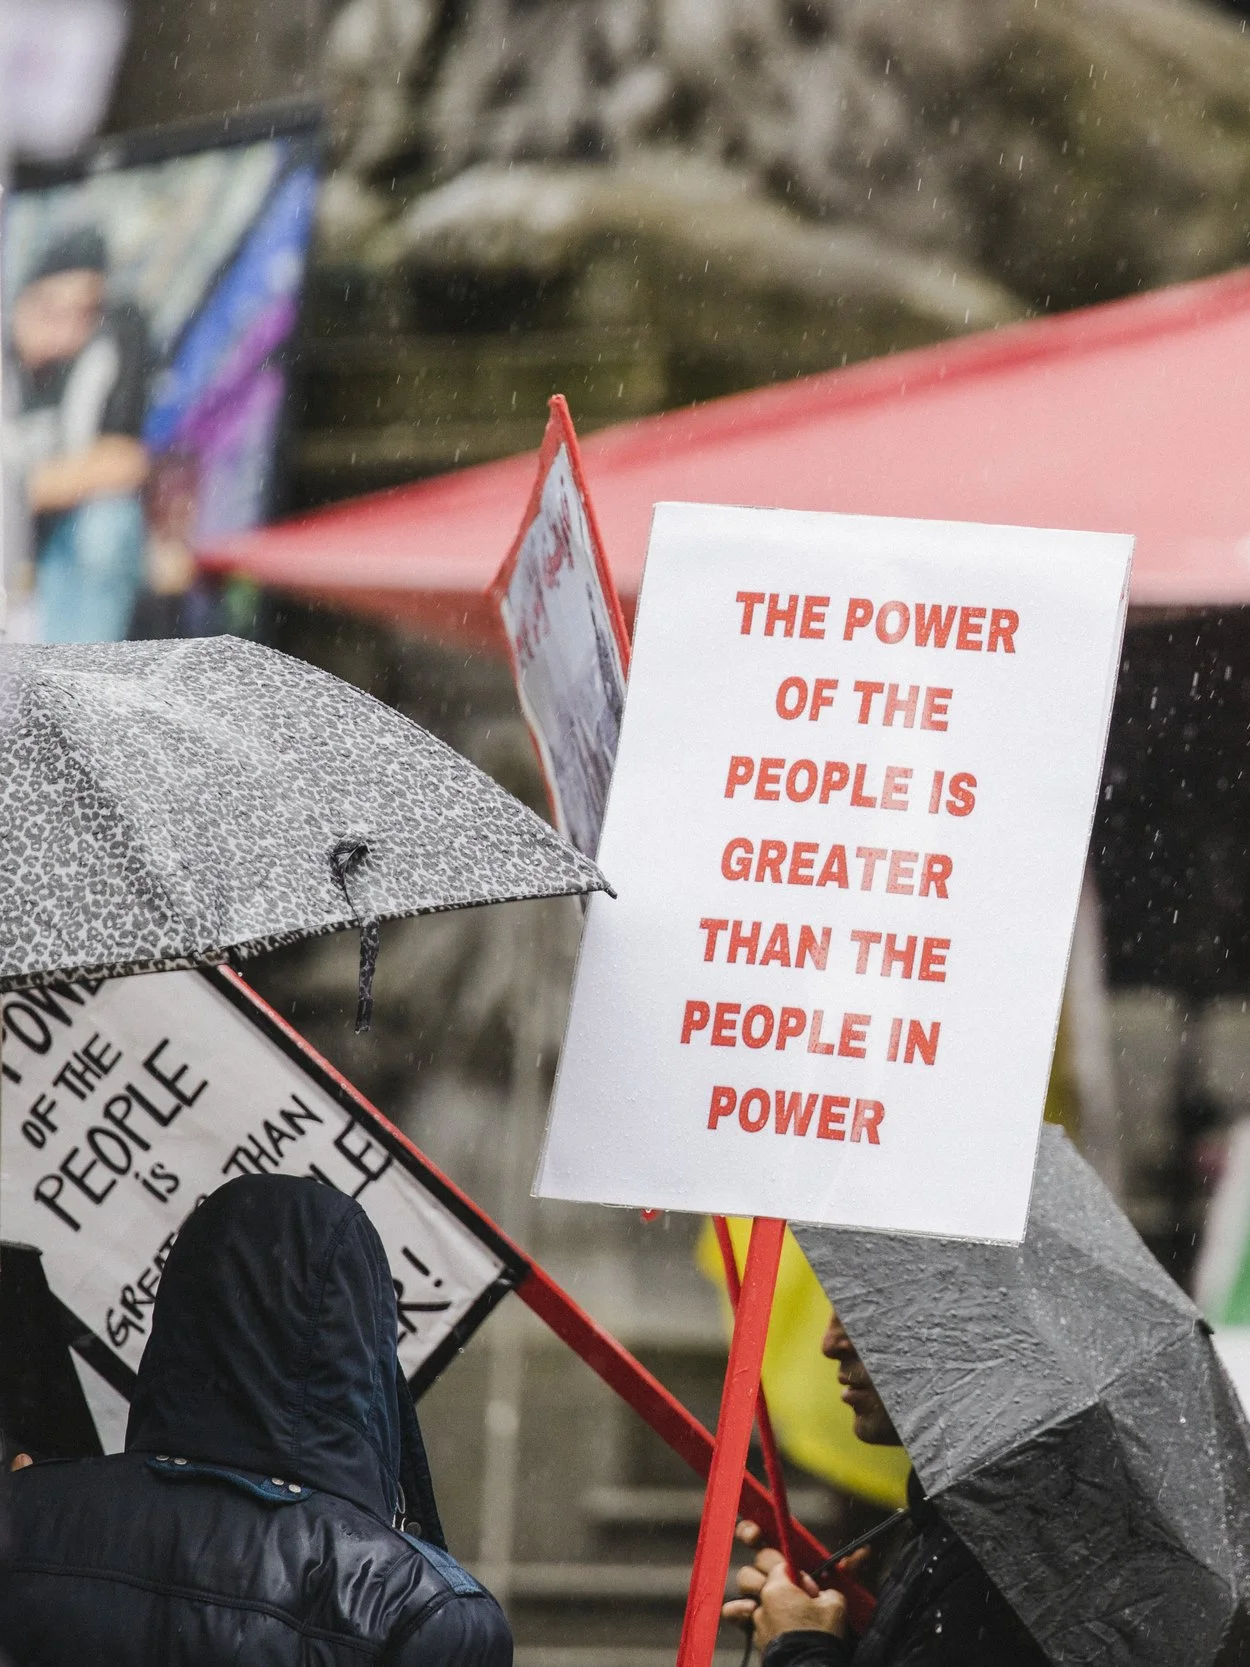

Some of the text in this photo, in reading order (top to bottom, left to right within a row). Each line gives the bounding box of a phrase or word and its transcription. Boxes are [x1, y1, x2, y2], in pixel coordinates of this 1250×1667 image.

[735, 591, 1020, 654] THE POWER
[775, 676, 953, 732] OF THE
[724, 755, 977, 817] PEOPLE IS
[720, 837, 954, 900] GREATER
[699, 917, 952, 983] THAN THE
[679, 999, 941, 1066] PEOPLE IN
[21, 1094, 58, 1150] OF
[52, 1032, 122, 1101] THE
[707, 1085, 885, 1146] POWER
[34, 1038, 208, 1232] PEOPLE
[222, 1094, 324, 1178] THAN
